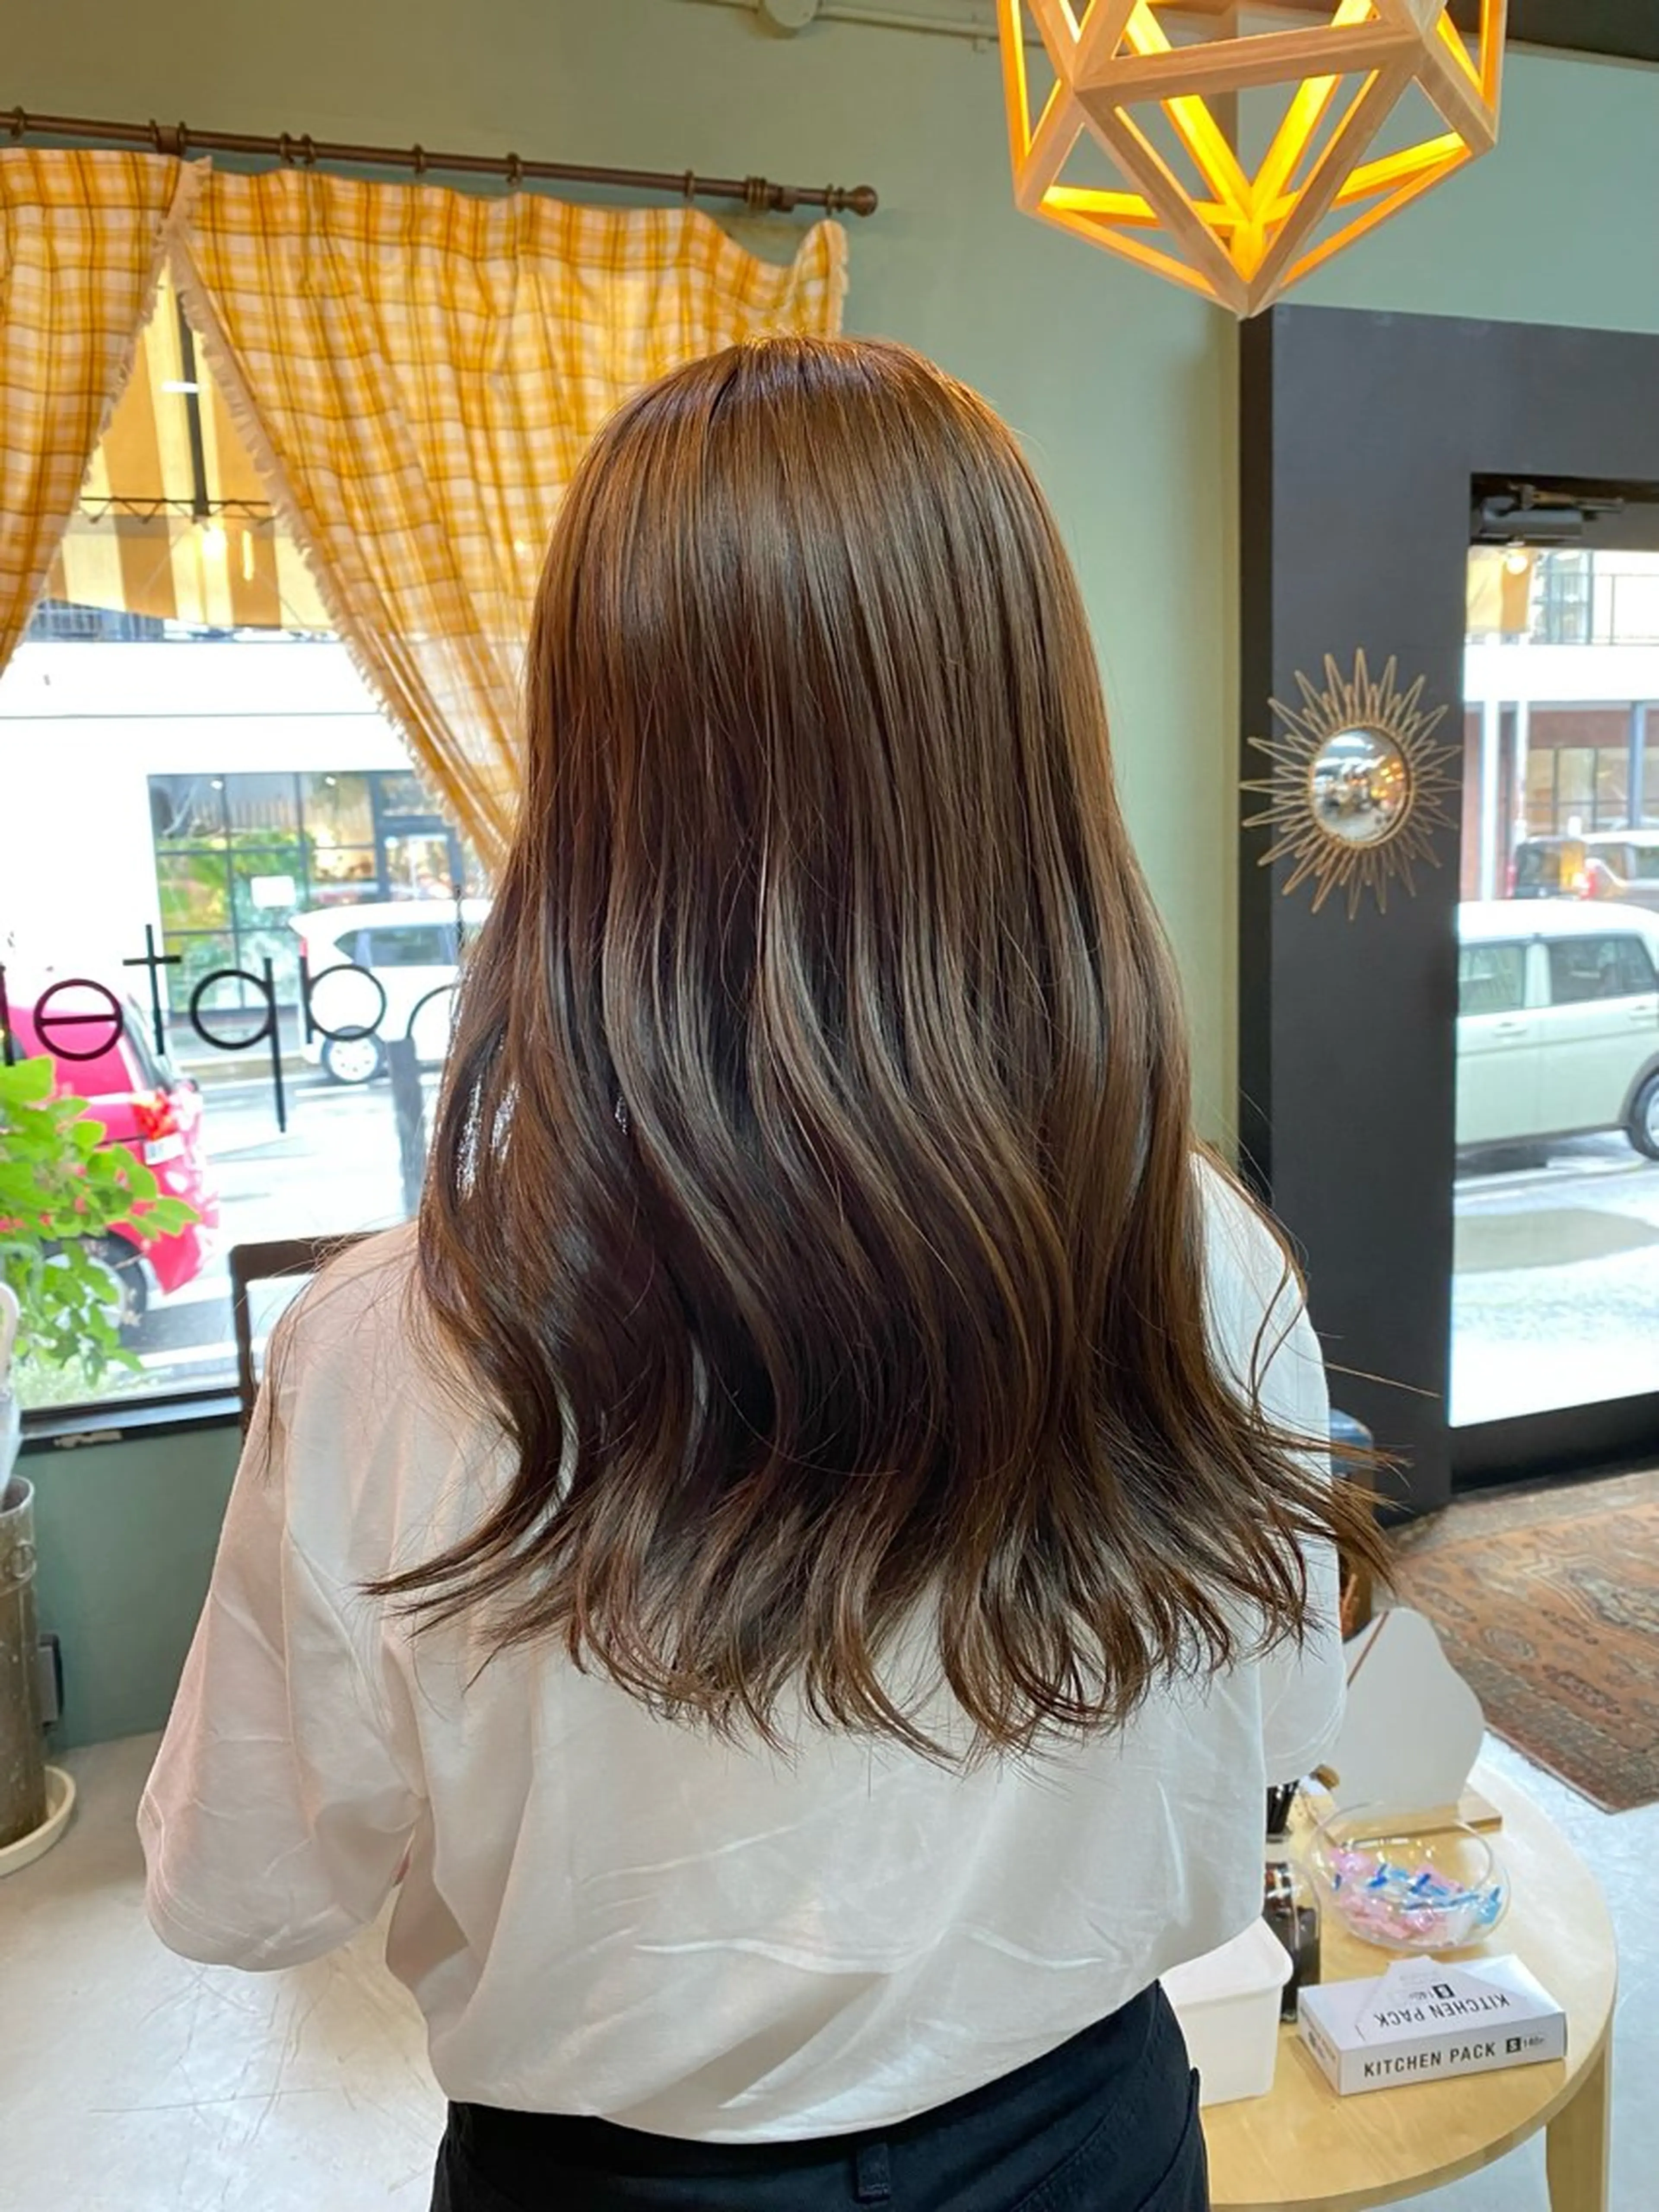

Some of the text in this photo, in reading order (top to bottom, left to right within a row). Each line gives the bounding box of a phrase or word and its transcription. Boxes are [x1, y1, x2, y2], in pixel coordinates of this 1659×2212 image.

[1373, 1993, 1510, 2028] KITCHEN PACK
[1363, 2050, 1442, 2078] KITCHEN
[1449, 2041, 1496, 2064] PACK
